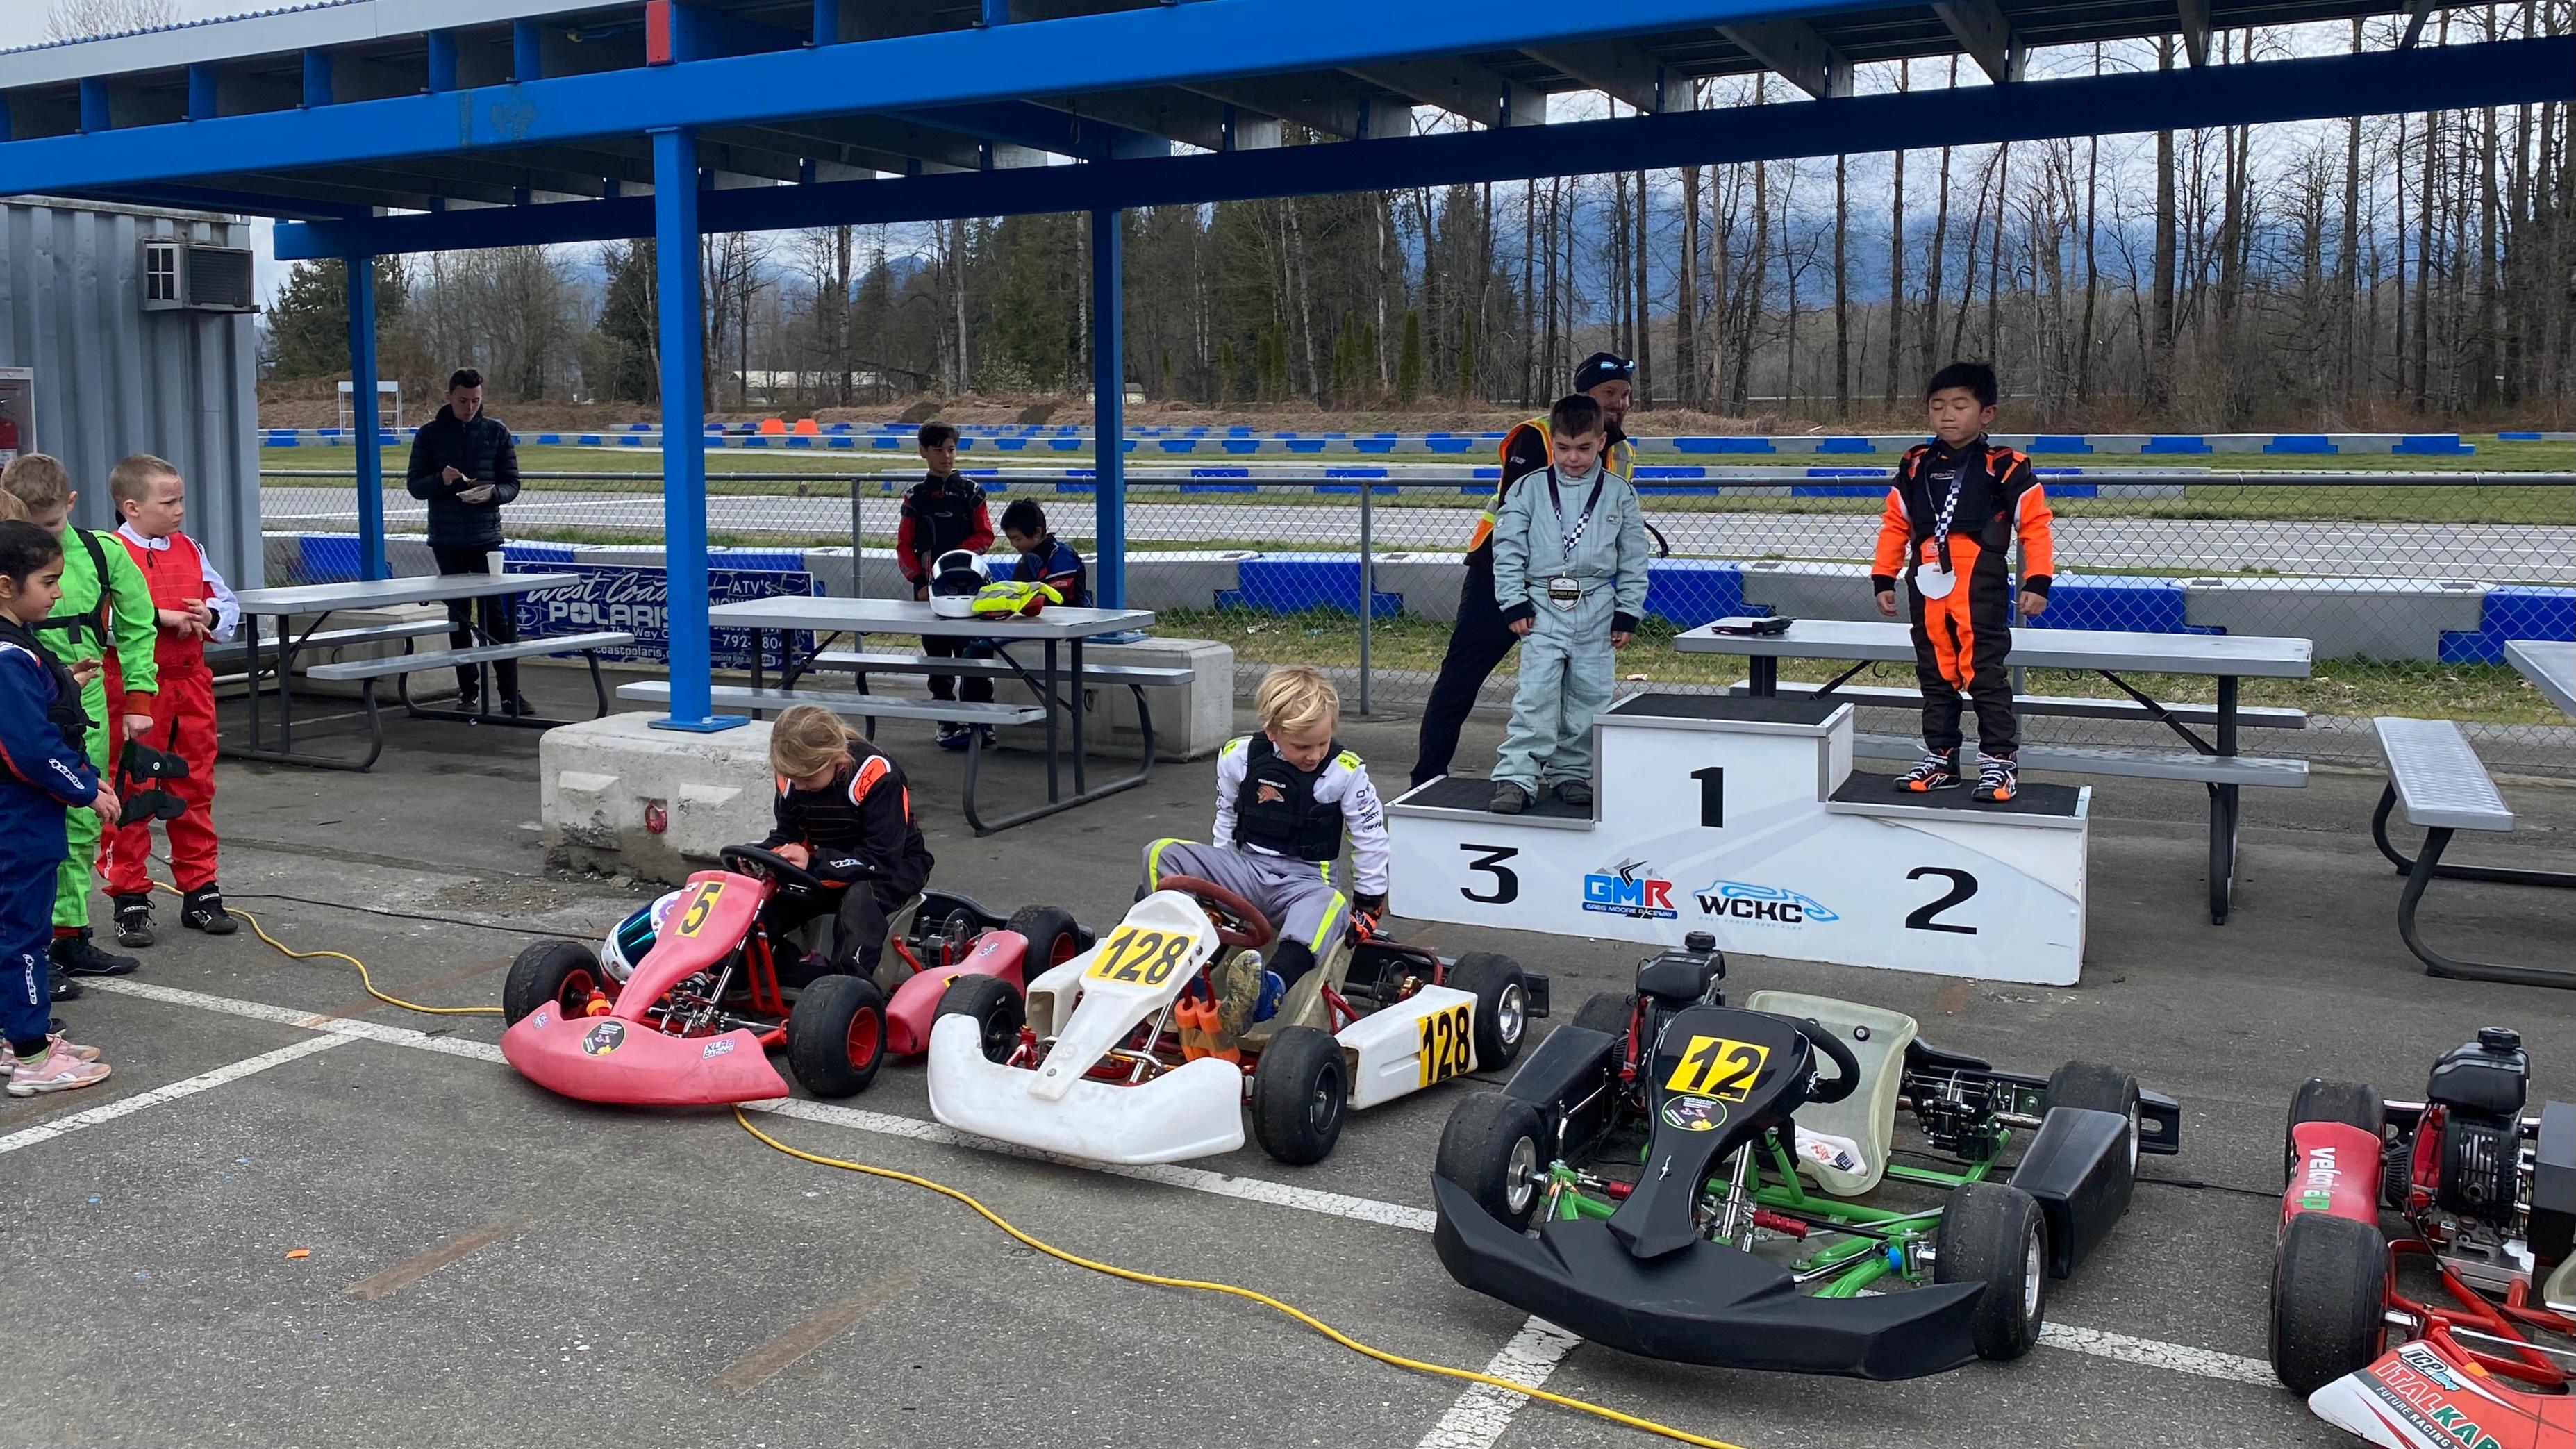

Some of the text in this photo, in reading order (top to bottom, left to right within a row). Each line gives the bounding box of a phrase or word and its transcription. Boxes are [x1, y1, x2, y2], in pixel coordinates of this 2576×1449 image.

[605, 571, 667, 604] Coas
[732, 580, 772, 595] ATV'S
[633, 627, 657, 640] Way
[1690, 766, 1723, 828] 1
[1460, 843, 1519, 904] 3
[1584, 874, 1675, 909] GMR
[681, 884, 722, 934] 5
[1608, 906, 1636, 914] MOORE
[1638, 909, 1673, 918] RACEWAY
[1697, 895, 1802, 923] WCKC
[1905, 866, 1978, 935] 2
[1099, 929, 1190, 984] 128
[1423, 1006, 1470, 1086] 128
[1687, 1041, 1761, 1100] 12
[2404, 1350, 2443, 1373] ICP
[2376, 1386, 2451, 1448] FUTURE RACING
